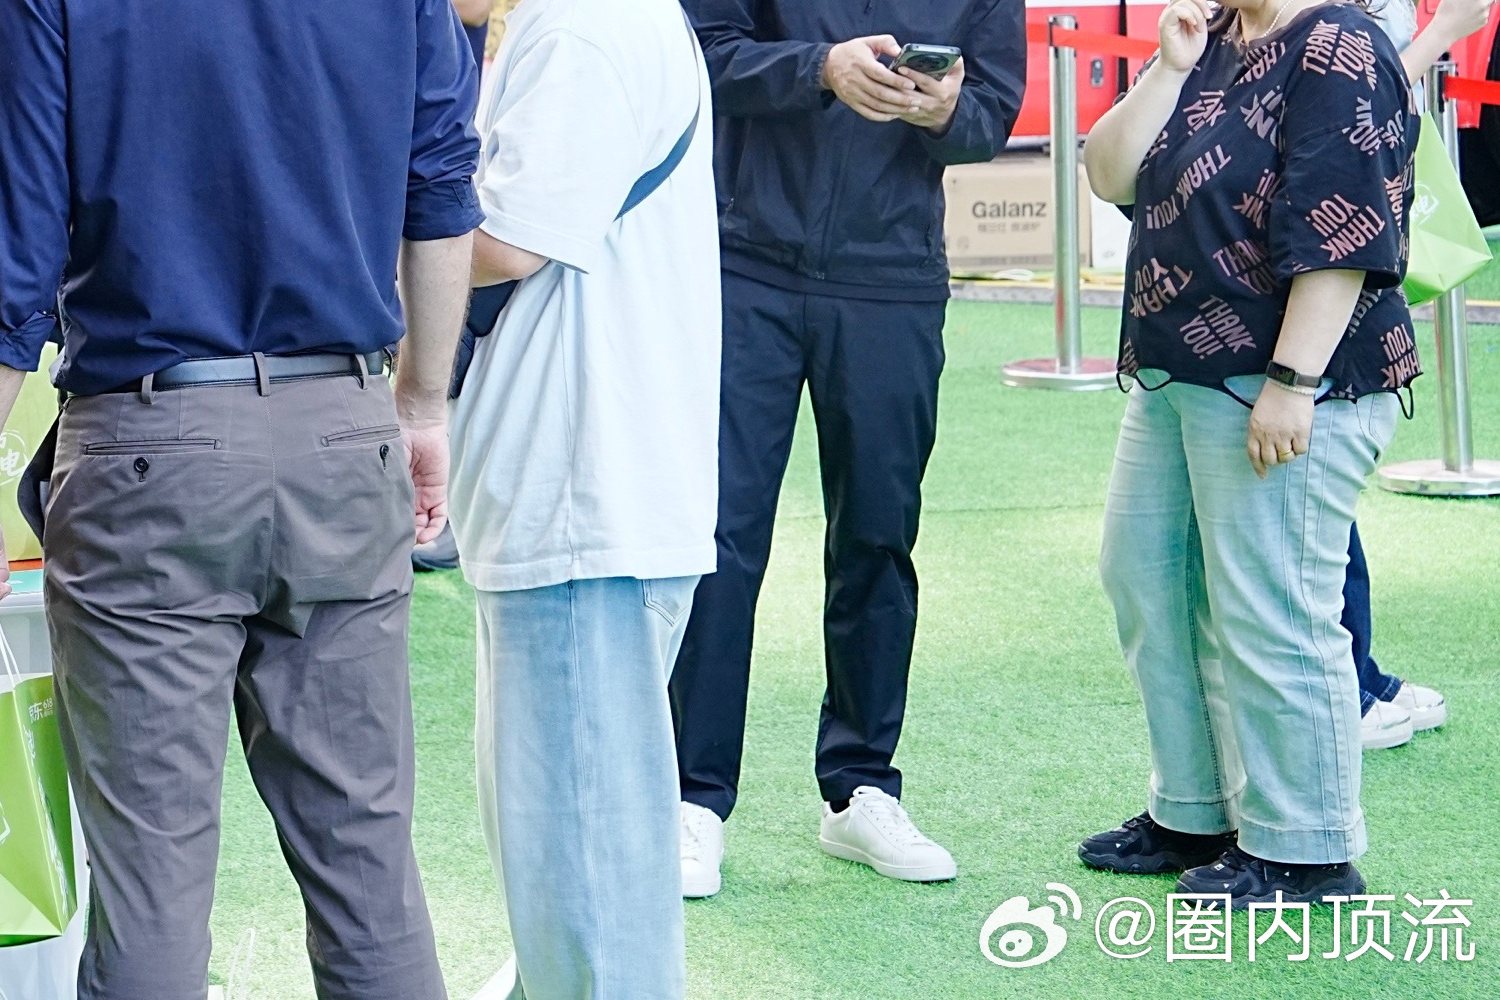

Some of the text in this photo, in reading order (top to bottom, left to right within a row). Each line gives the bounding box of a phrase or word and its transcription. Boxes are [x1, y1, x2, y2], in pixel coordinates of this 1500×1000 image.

[1303, 19, 1340, 75] THANK
[972, 201, 1047, 219] Galanz
[1306, 193, 1359, 237] YOU!
[1320, 205, 1385, 262] THANK
[1179, 315, 1224, 360] YOU!
[1199, 294, 1257, 354] THANK
[1380, 323, 1414, 362] YOU!
